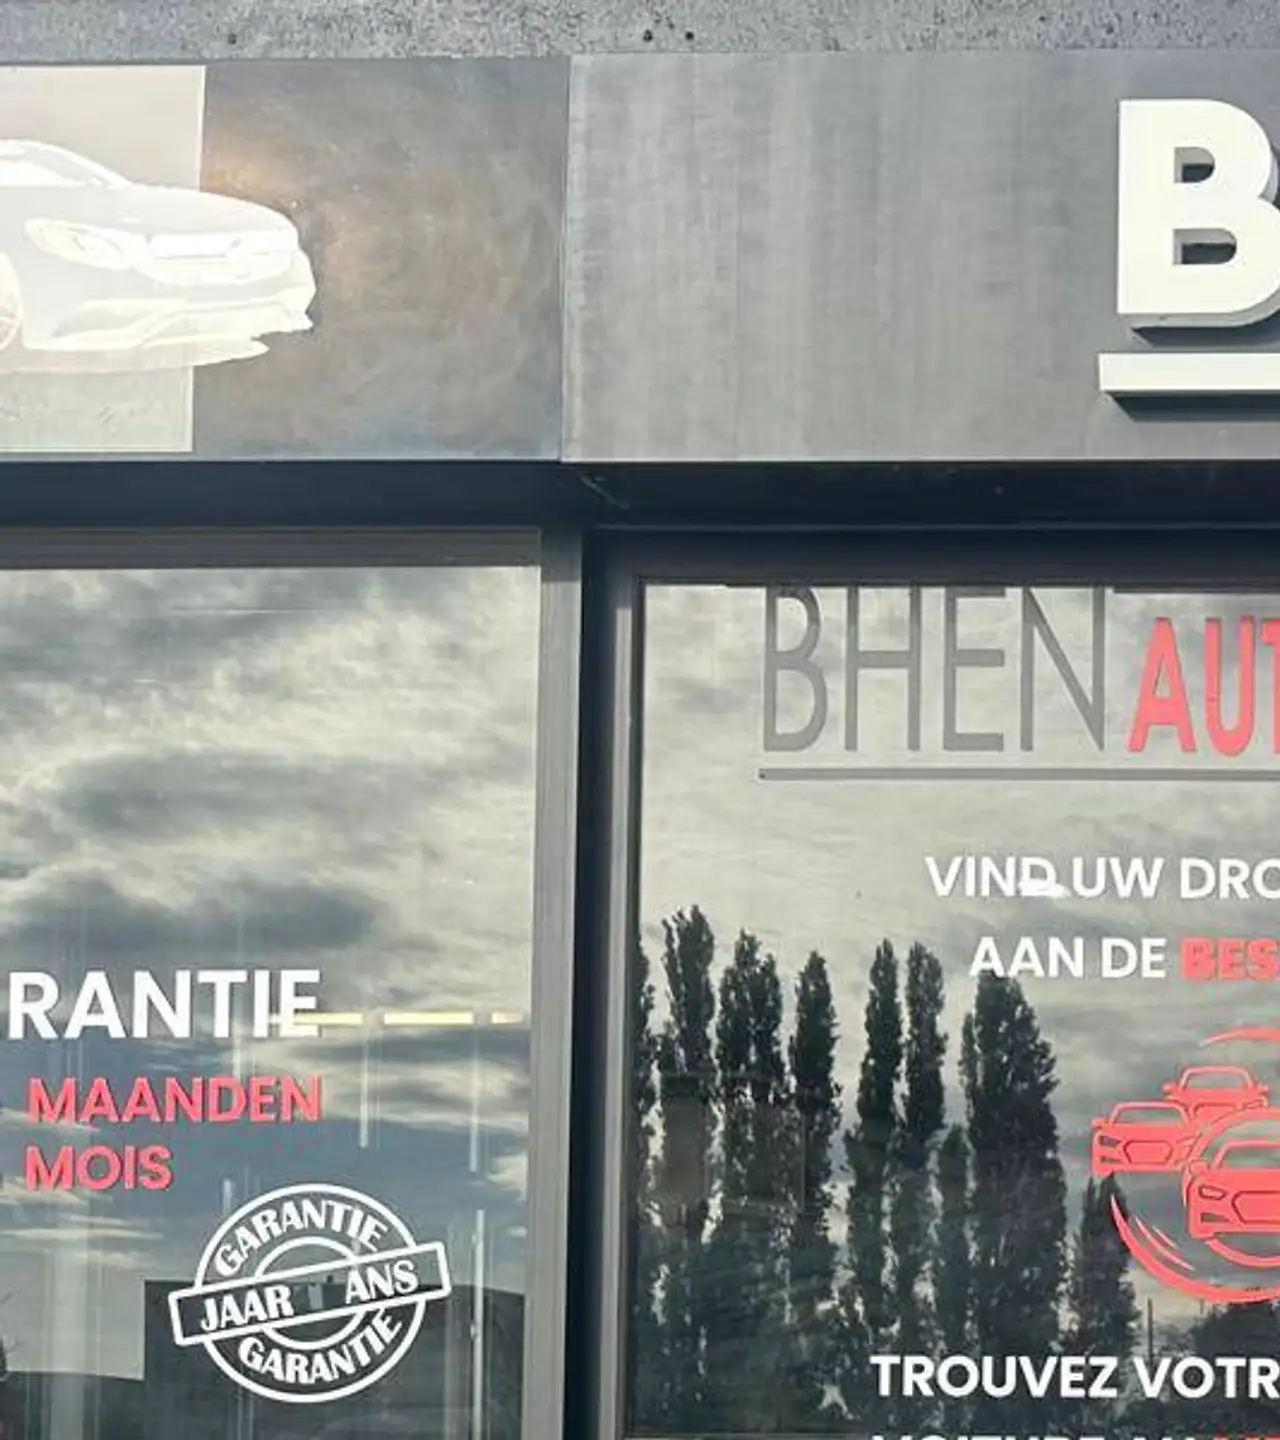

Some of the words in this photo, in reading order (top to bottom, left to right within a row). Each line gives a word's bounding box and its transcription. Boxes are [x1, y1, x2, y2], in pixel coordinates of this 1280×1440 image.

[763, 584, 1106, 751] BHEN
[925, 857, 1058, 899] VIND
[1071, 857, 1165, 898] UW
[968, 937, 1084, 979] AAN
[1101, 937, 1167, 979] DE
[27, 1075, 323, 1122] MAANDEN
[24, 1145, 173, 1190] MOIS
[214, 1200, 388, 1277] GARANTIE
[200, 1284, 295, 1332] JAAR
[345, 1259, 420, 1305] ANS
[238, 1307, 403, 1385] GARANTIE
[871, 1355, 1118, 1399] TROUVEZ
